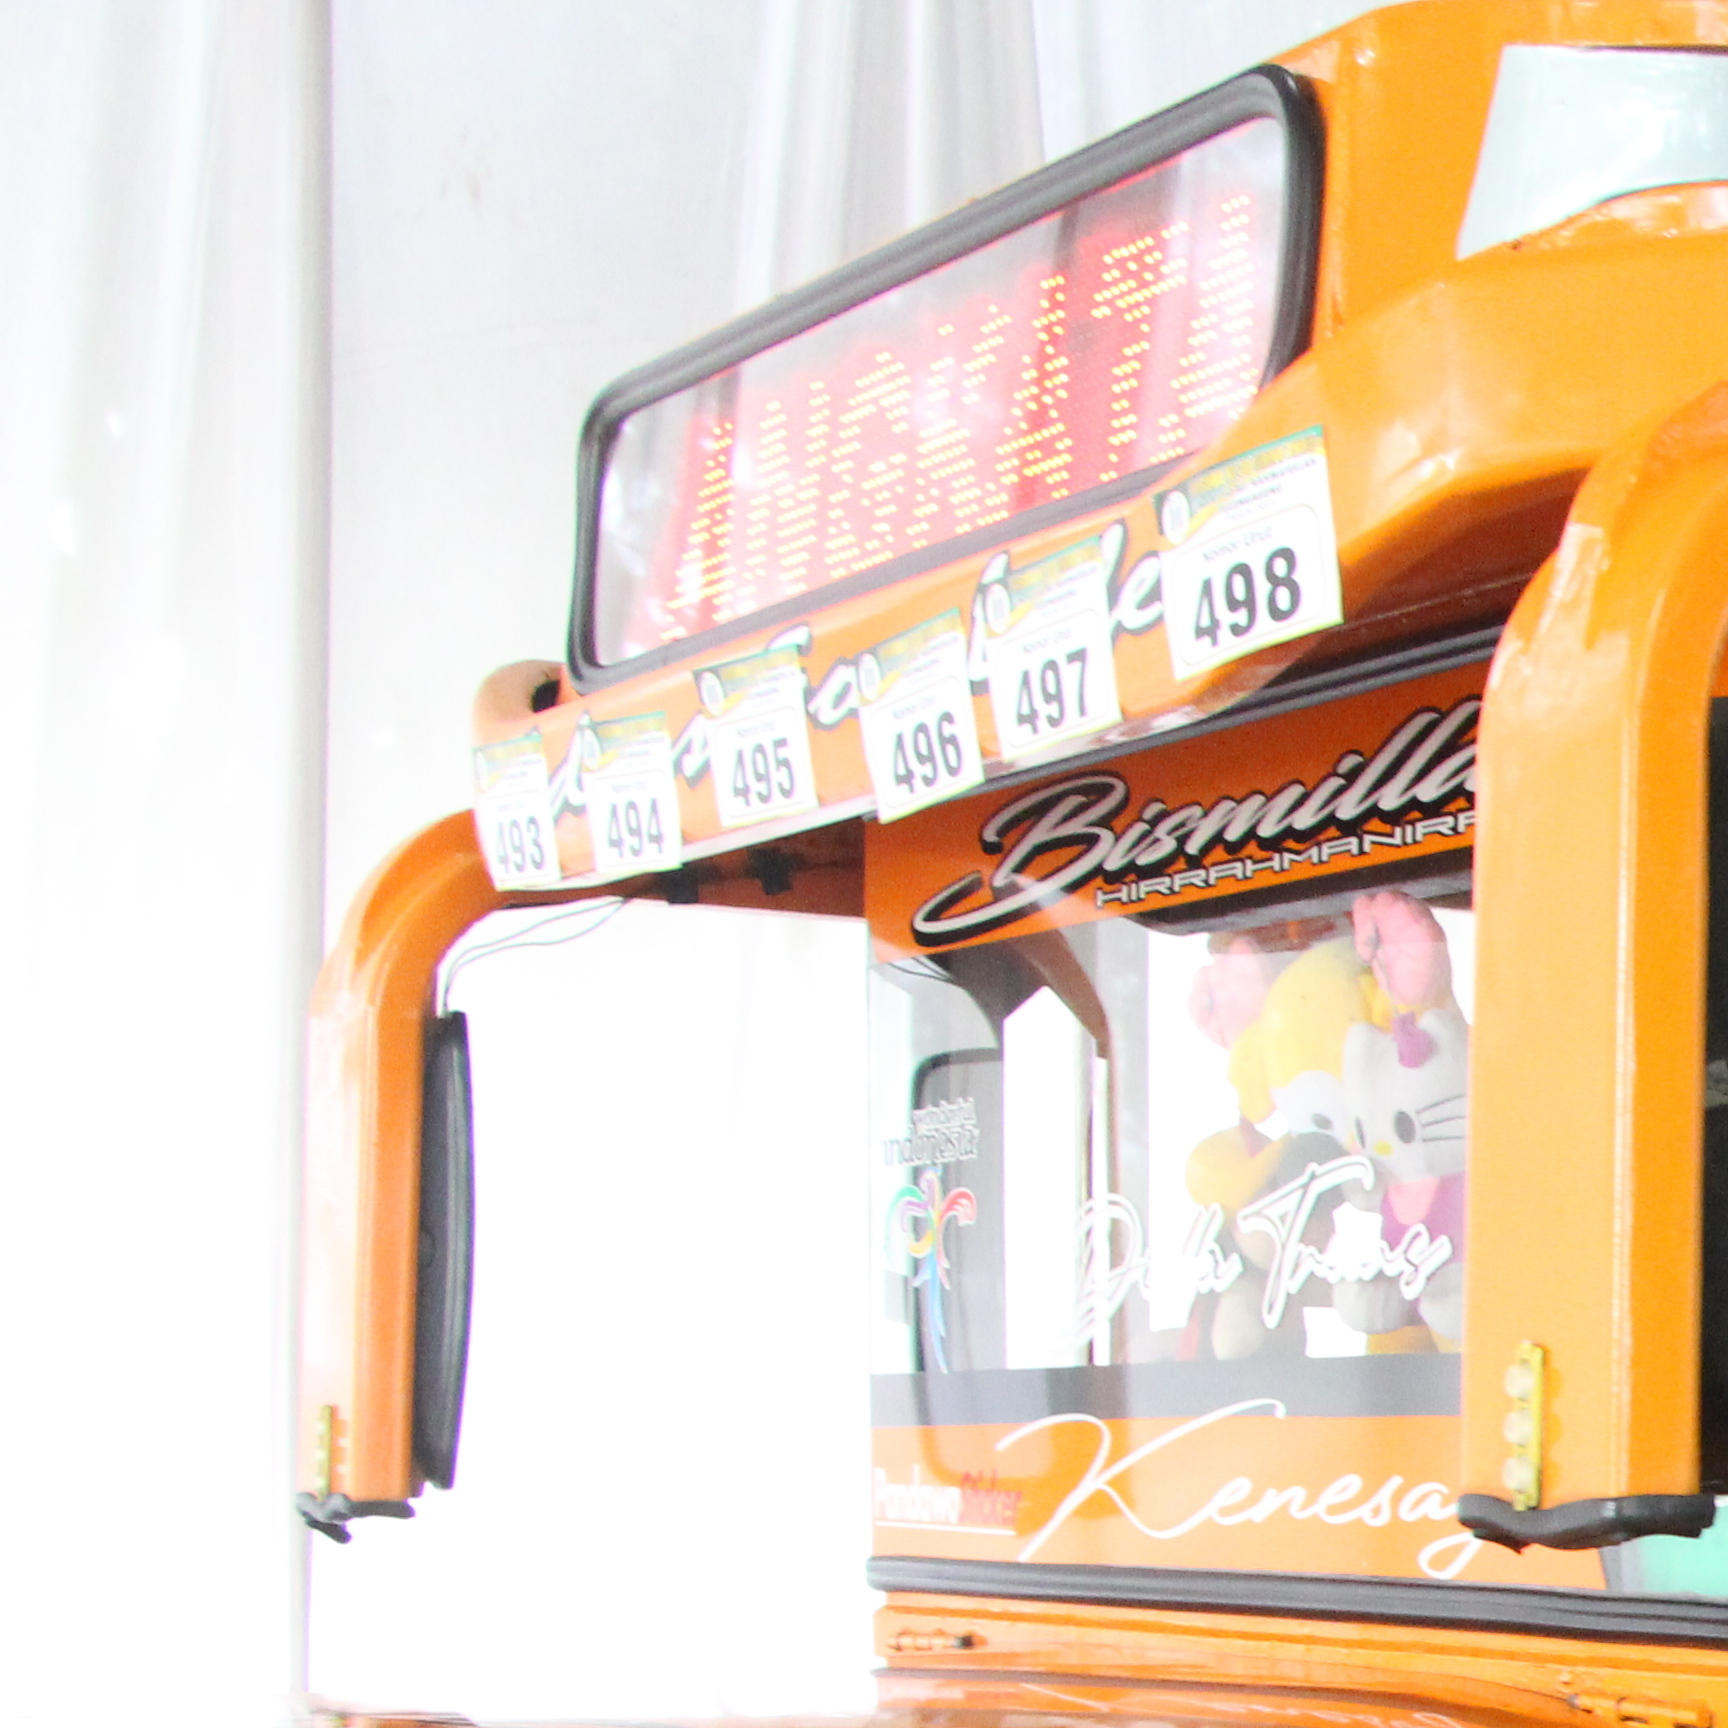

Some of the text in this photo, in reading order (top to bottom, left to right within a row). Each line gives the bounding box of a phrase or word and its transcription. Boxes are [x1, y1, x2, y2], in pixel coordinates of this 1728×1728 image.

[1194, 546, 1302, 648] 498
[1016, 646, 1087, 735] 497
[733, 737, 794, 807] 495
[893, 710, 962, 794] 496
[496, 815, 544, 874] 493
[608, 797, 664, 858] 494
